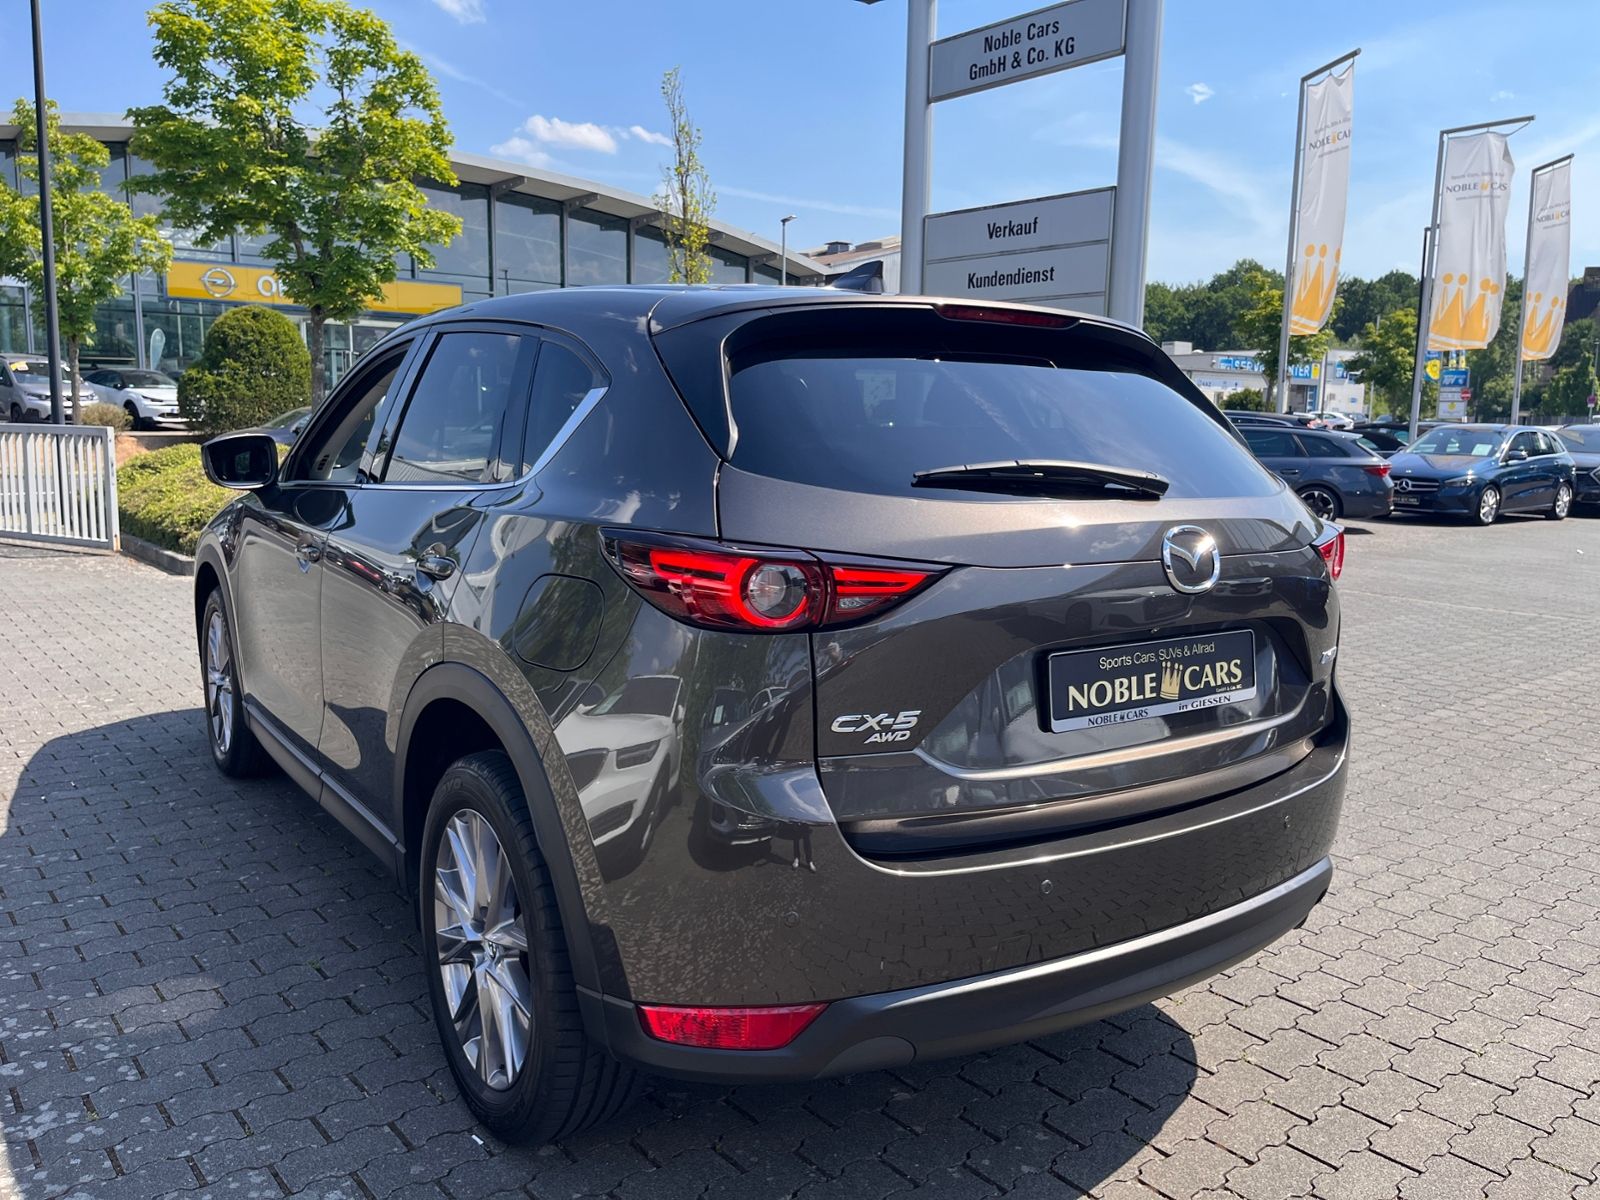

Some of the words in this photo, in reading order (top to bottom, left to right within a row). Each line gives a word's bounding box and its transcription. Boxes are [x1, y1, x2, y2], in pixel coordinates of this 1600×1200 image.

[984, 29, 1021, 53] Noble
[1027, 20, 1060, 40] Cars
[969, 55, 1006, 81] GmbH
[1011, 51, 1022, 69] &
[1027, 47, 1049, 65] Co.
[1054, 36, 1075, 58] KG
[1446, 182, 1479, 193] NOBLE
[987, 216, 1039, 240] Verkauf
[967, 266, 1055, 289] Kundendienst
[1099, 655, 1132, 670] Sports
[1133, 652, 1157, 665] Cars,
[1158, 648, 1182, 660] SUVs
[1183, 646, 1190, 656] &
[1191, 642, 1215, 655] Allrad
[1068, 673, 1157, 711] NOBLE
[1184, 659, 1243, 691] CARS
[831, 710, 922, 733] CX-5
[1087, 714, 1118, 727] NOBLE
[1127, 709, 1149, 720] CARS
[1178, 703, 1188, 711] in
[1191, 695, 1231, 709] GIESSEN
[863, 730, 911, 744] AWD
